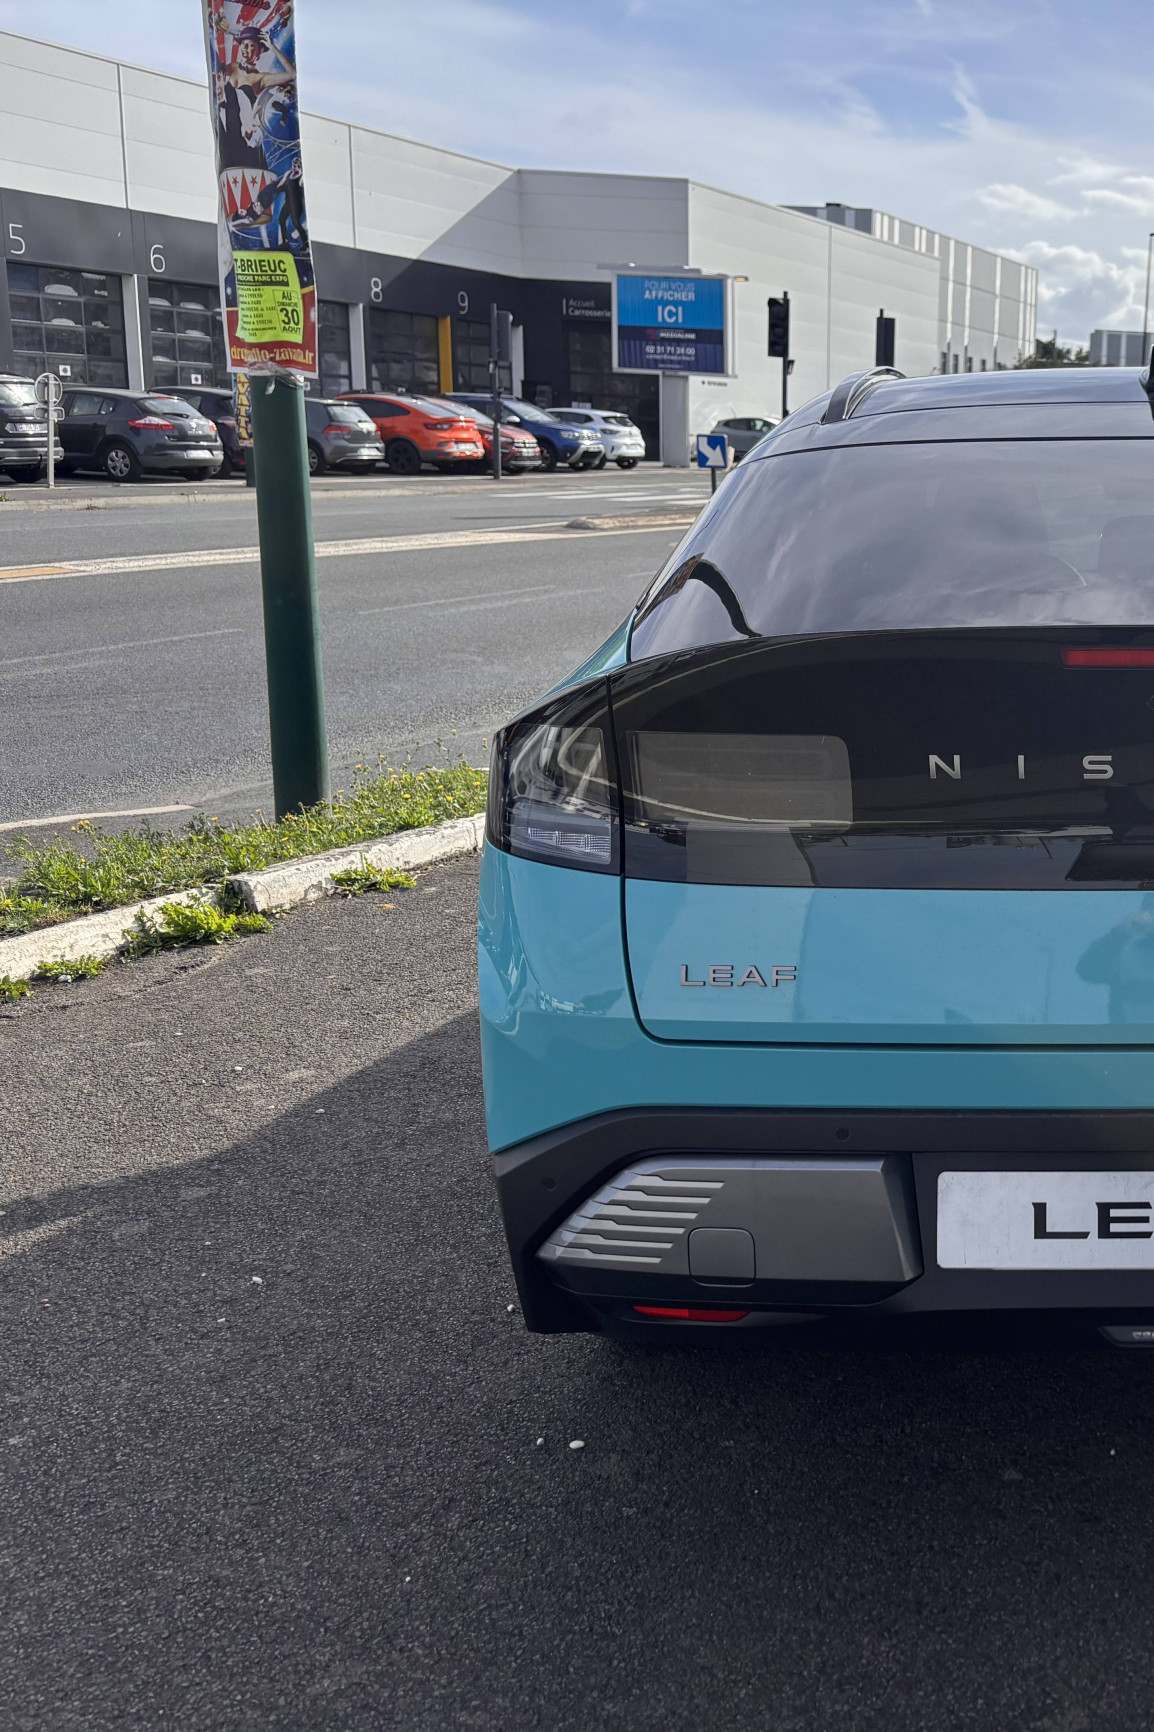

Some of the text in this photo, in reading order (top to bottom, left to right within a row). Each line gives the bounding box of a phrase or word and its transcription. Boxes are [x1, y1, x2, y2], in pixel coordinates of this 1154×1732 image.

[9, 223, 26, 255] 5
[150, 244, 166, 273] 6
[282, 291, 292, 301] AU
[370, 277, 383, 303] 8
[457, 290, 469, 315] 9
[644, 289, 696, 302] AFFICHER
[279, 308, 300, 326] 30
[657, 305, 683, 323] ICI
[680, 963, 797, 988] LEAF
